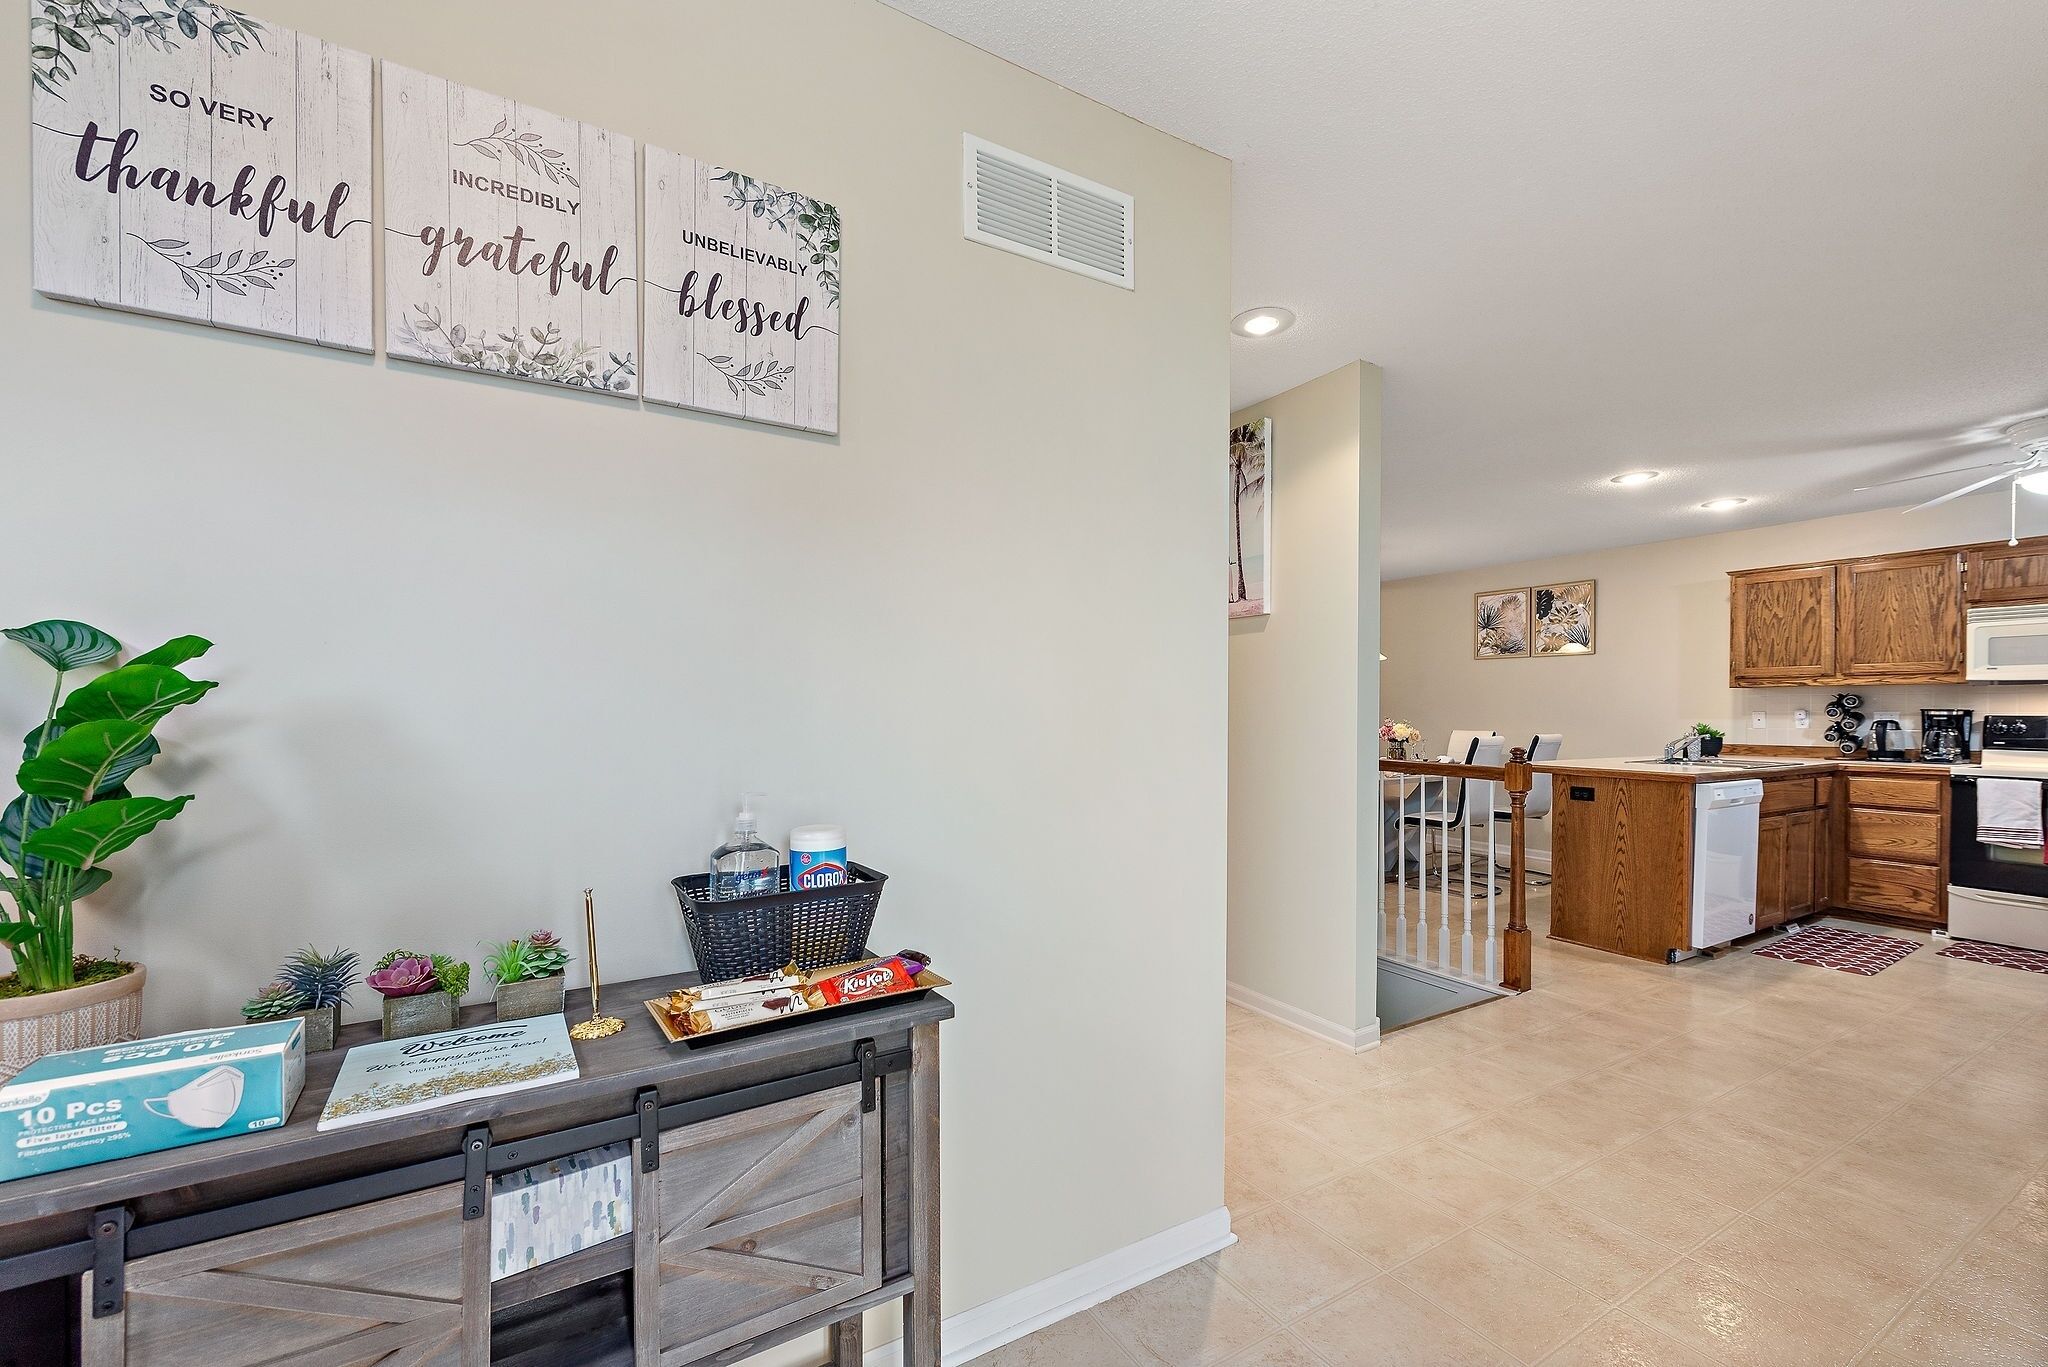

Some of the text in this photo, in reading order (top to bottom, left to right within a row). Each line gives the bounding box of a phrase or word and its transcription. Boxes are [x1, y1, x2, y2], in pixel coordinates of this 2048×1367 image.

[149, 83, 274, 131] SO VERY
[75, 121, 350, 239] thankful
[452, 169, 580, 216] INCREDIBLY
[419, 224, 620, 297] grateful
[681, 229, 807, 277] UNBELIEVABLY
[678, 270, 810, 341] blessed
[803, 870, 847, 888] CLOROX
[399, 1030, 526, 1055] Welcome
[17, 1107, 56, 1127] 10
[18, 1113, 122, 1136] PROTECTIVE FACE MASK
[252, 1120, 265, 1129] 10
[26, 1123, 117, 1145] Five layer filter
[17, 1145, 60, 1158] Filtration
[62, 1137, 106, 1151] efficiency
